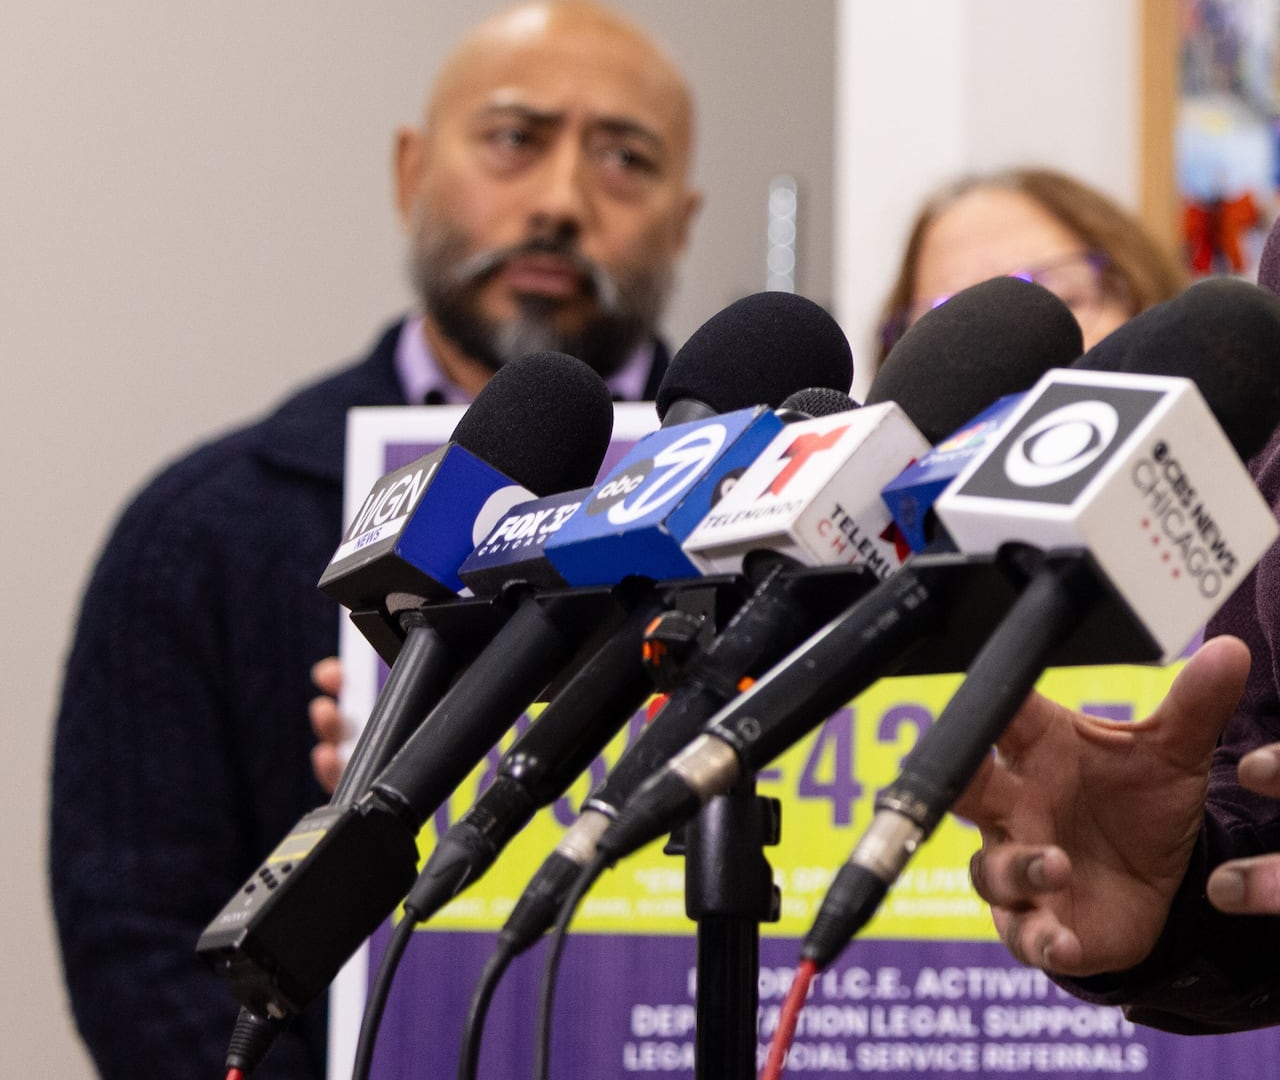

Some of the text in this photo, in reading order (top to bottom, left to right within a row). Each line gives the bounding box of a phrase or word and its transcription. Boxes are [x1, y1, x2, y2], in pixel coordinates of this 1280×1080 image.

[597, 474, 645, 500] abc
[607, 423, 727, 524] 7
[350, 462, 438, 540] WGN
[486, 501, 582, 545] FOX 32
[354, 527, 383, 551] NEWS
[830, 503, 892, 579] TELEM
[1131, 458, 1222, 599] CHICAGO
[1191, 502, 1239, 577] NEWS
[821, 967, 911, 1001] I.C.E.
[870, 1005, 980, 1038] LEGAL
[983, 1005, 1136, 1038] SUPPORT
[856, 1041, 979, 1072] SERVICE
[982, 1042, 1149, 1072] REFERRALS
